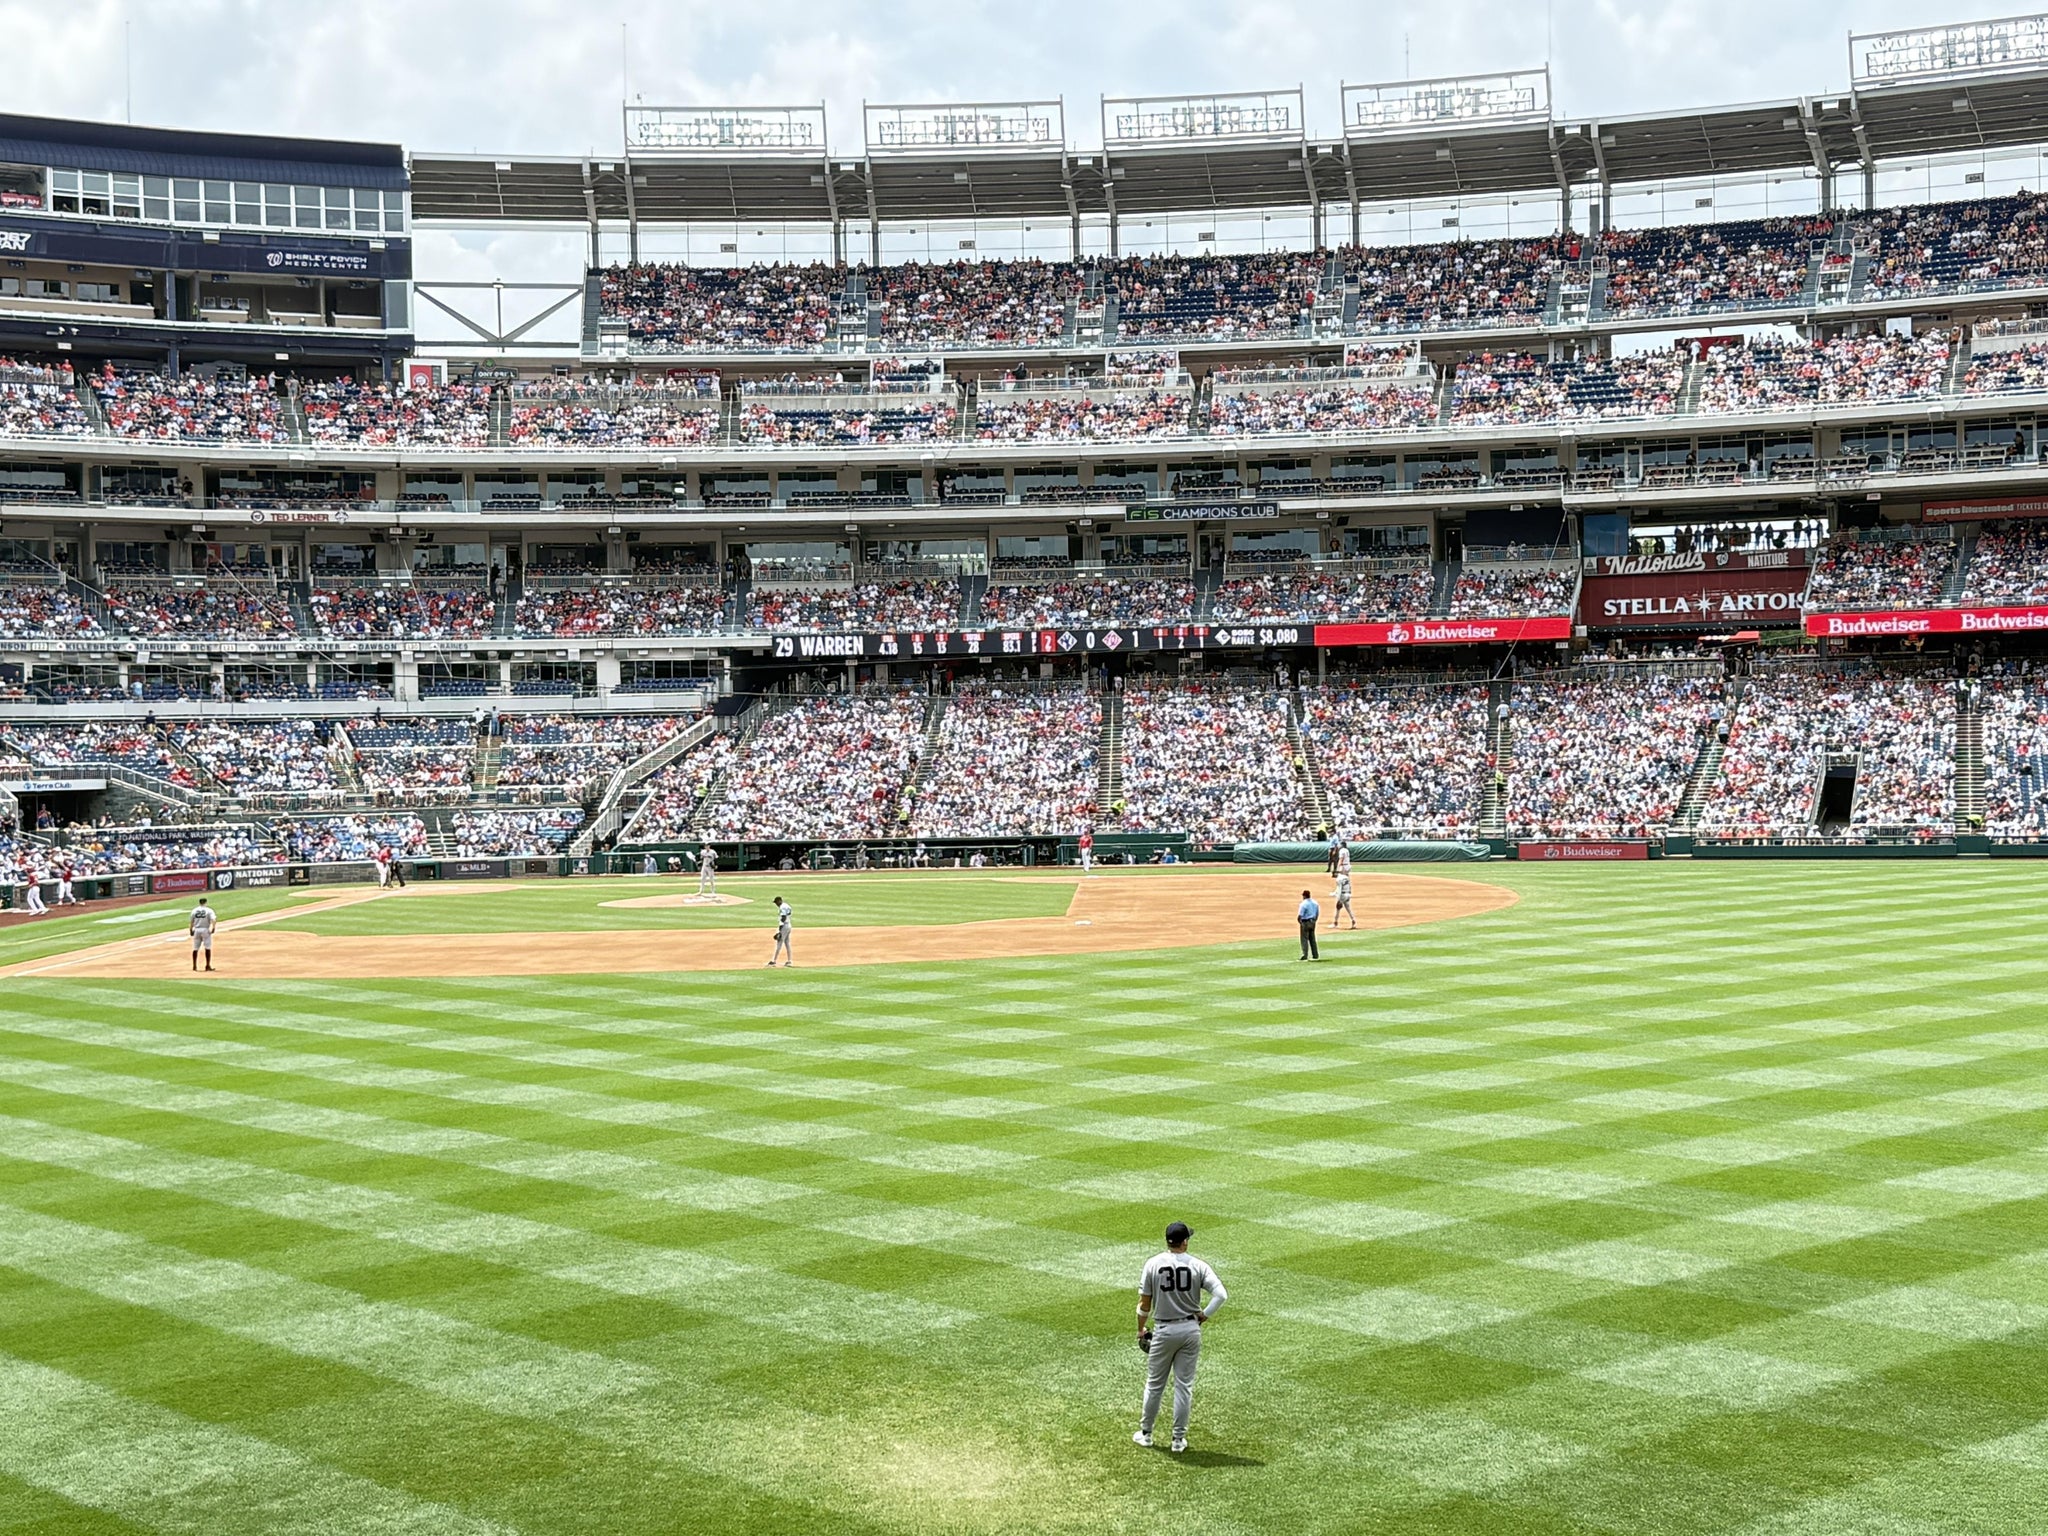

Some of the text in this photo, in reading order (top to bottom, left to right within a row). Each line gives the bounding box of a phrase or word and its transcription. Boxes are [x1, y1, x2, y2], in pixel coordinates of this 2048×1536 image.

[285, 253, 368, 264] SHIRLEY POVICH
[1163, 507, 1237, 519] CHAMPIONS
[1241, 505, 1274, 516] CLUB
[1962, 504, 2014, 513] Illustrated
[2017, 503, 2041, 511] TICKETS
[271, 513, 289, 521] TED
[1605, 550, 1706, 575] Nationals
[1748, 552, 1789, 567] NATITUDE
[1604, 596, 1690, 616] STELLA
[1414, 624, 1498, 640] Budweiser
[1828, 617, 1930, 634] Budweiser
[1044, 635, 1052, 652] 2
[1086, 632, 1095, 648] 0
[1260, 628, 1298, 646] $8,080
[776, 635, 864, 657] 29 WARREN
[879, 642, 899, 655] 4.18
[968, 641, 980, 653] 28
[1003, 640, 1021, 652] 83.1
[129, 831, 167, 841] NATIONALS
[1563, 845, 1622, 856] Budweiser
[235, 868, 284, 878] NATIONALS
[167, 878, 205, 887] Budweiser
[249, 877, 272, 885] PARK
[1158, 1266, 1192, 1292] 30
